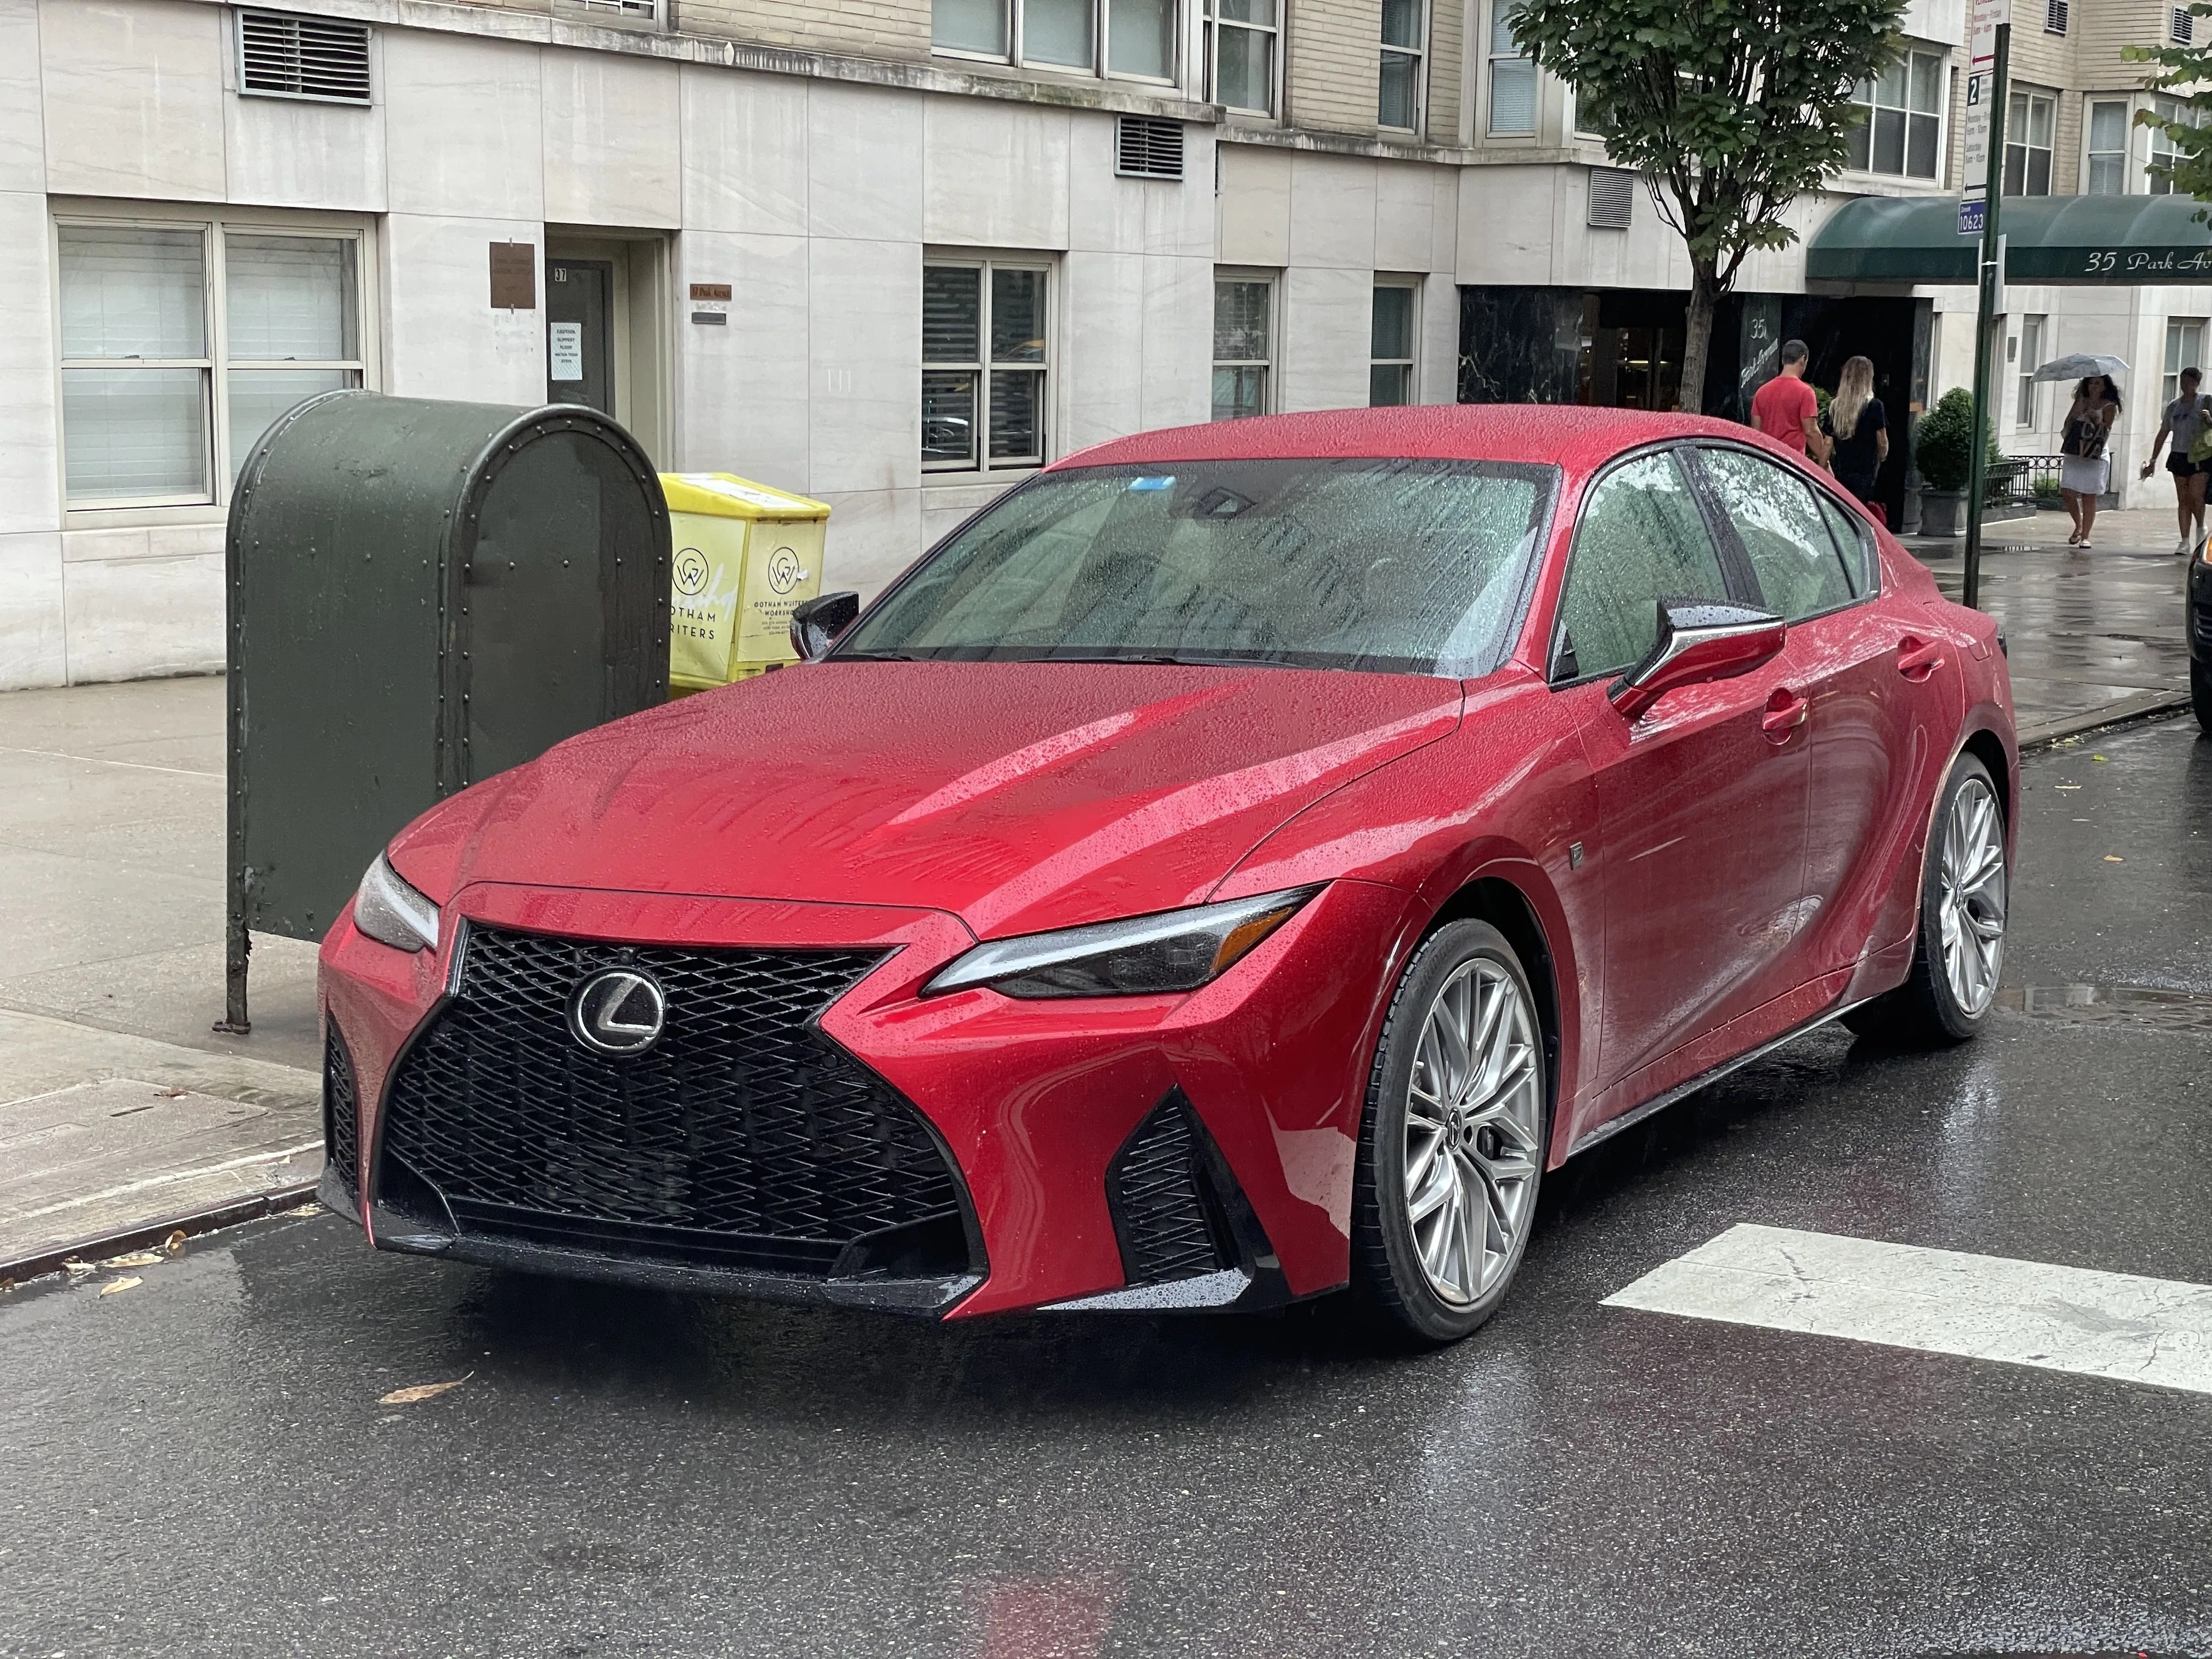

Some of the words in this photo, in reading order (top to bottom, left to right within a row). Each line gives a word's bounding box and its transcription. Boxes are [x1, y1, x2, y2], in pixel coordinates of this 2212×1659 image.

[1970, 78, 1977, 104] 2
[1960, 213, 1984, 231] 10623
[2084, 252, 2118, 272] 35
[2125, 251, 2175, 270] Park
[556, 269, 566, 281] 37
[1751, 319, 1765, 338] 35
[670, 605, 716, 622] OTHAM
[670, 623, 715, 640] RITERS
